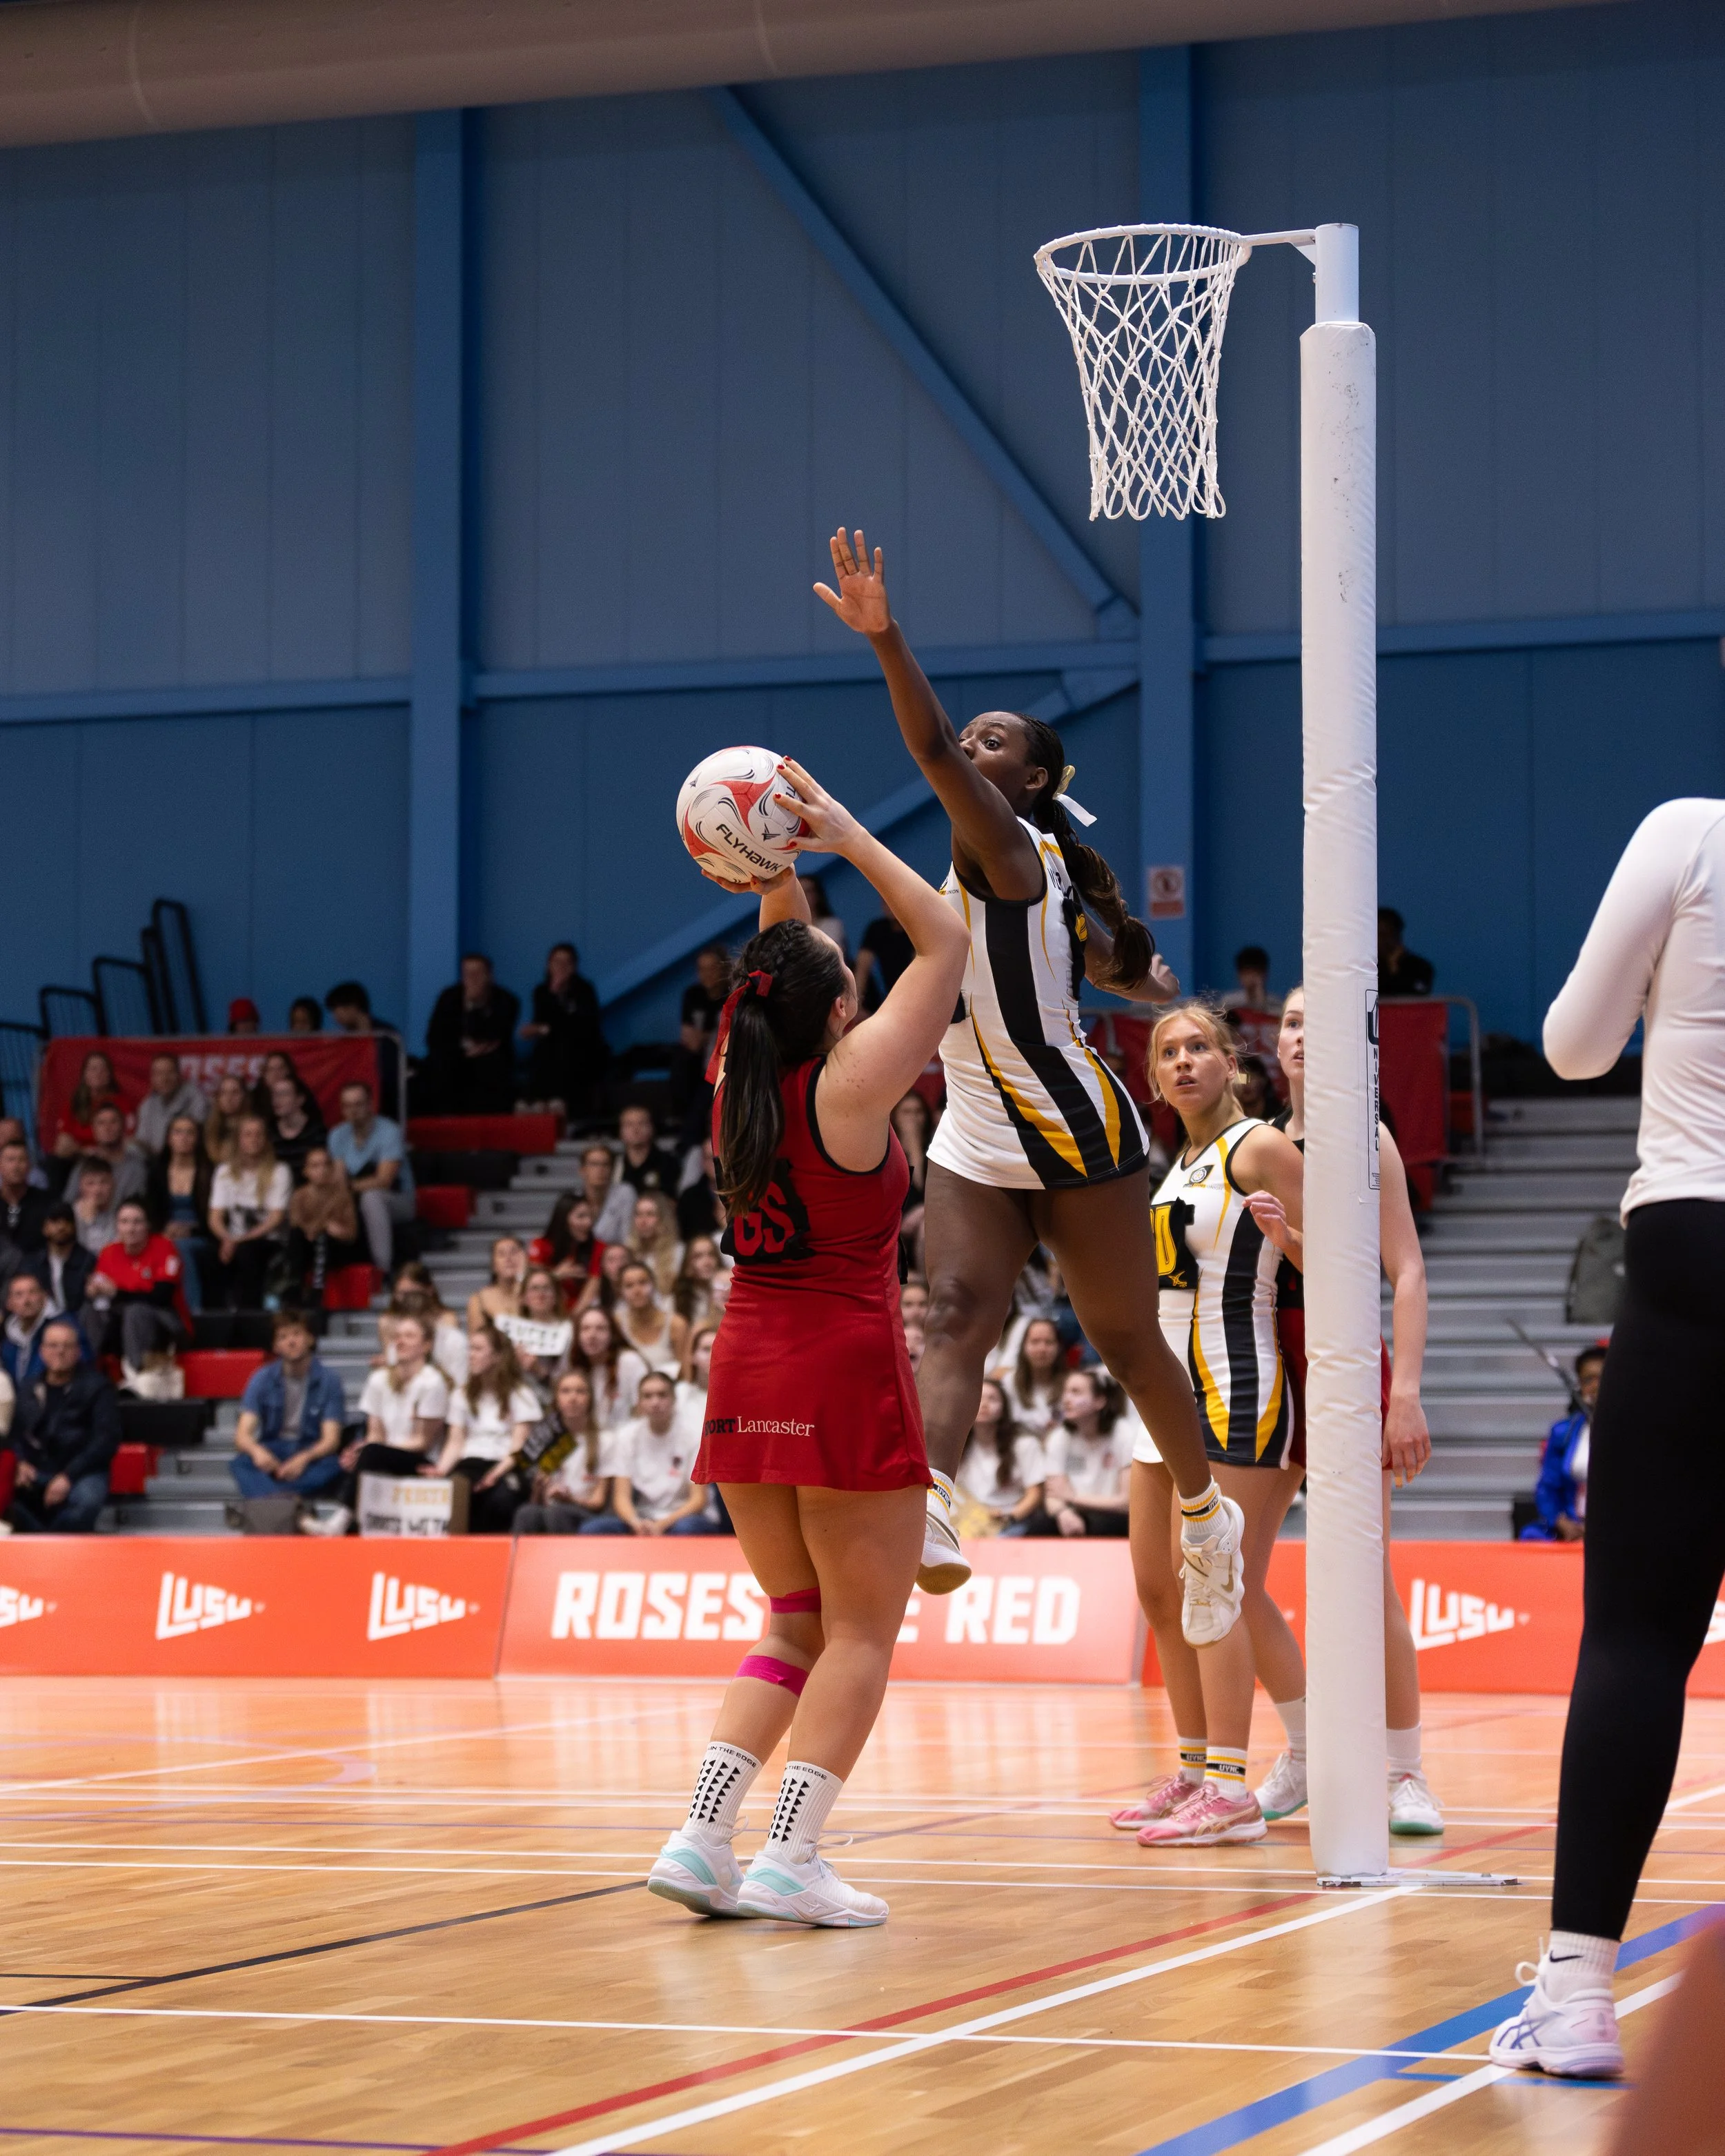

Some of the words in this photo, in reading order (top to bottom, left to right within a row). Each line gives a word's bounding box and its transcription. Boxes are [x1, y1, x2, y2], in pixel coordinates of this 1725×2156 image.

[733, 1181, 795, 1256] GS
[737, 1416, 815, 1436] Lancaster
[551, 1572, 770, 1641] ROSES
[945, 1576, 1081, 1644] RED
[719, 1746, 735, 1754] THE
[736, 1752, 757, 1768] EDGE
[802, 1767, 827, 1780] EDGE
